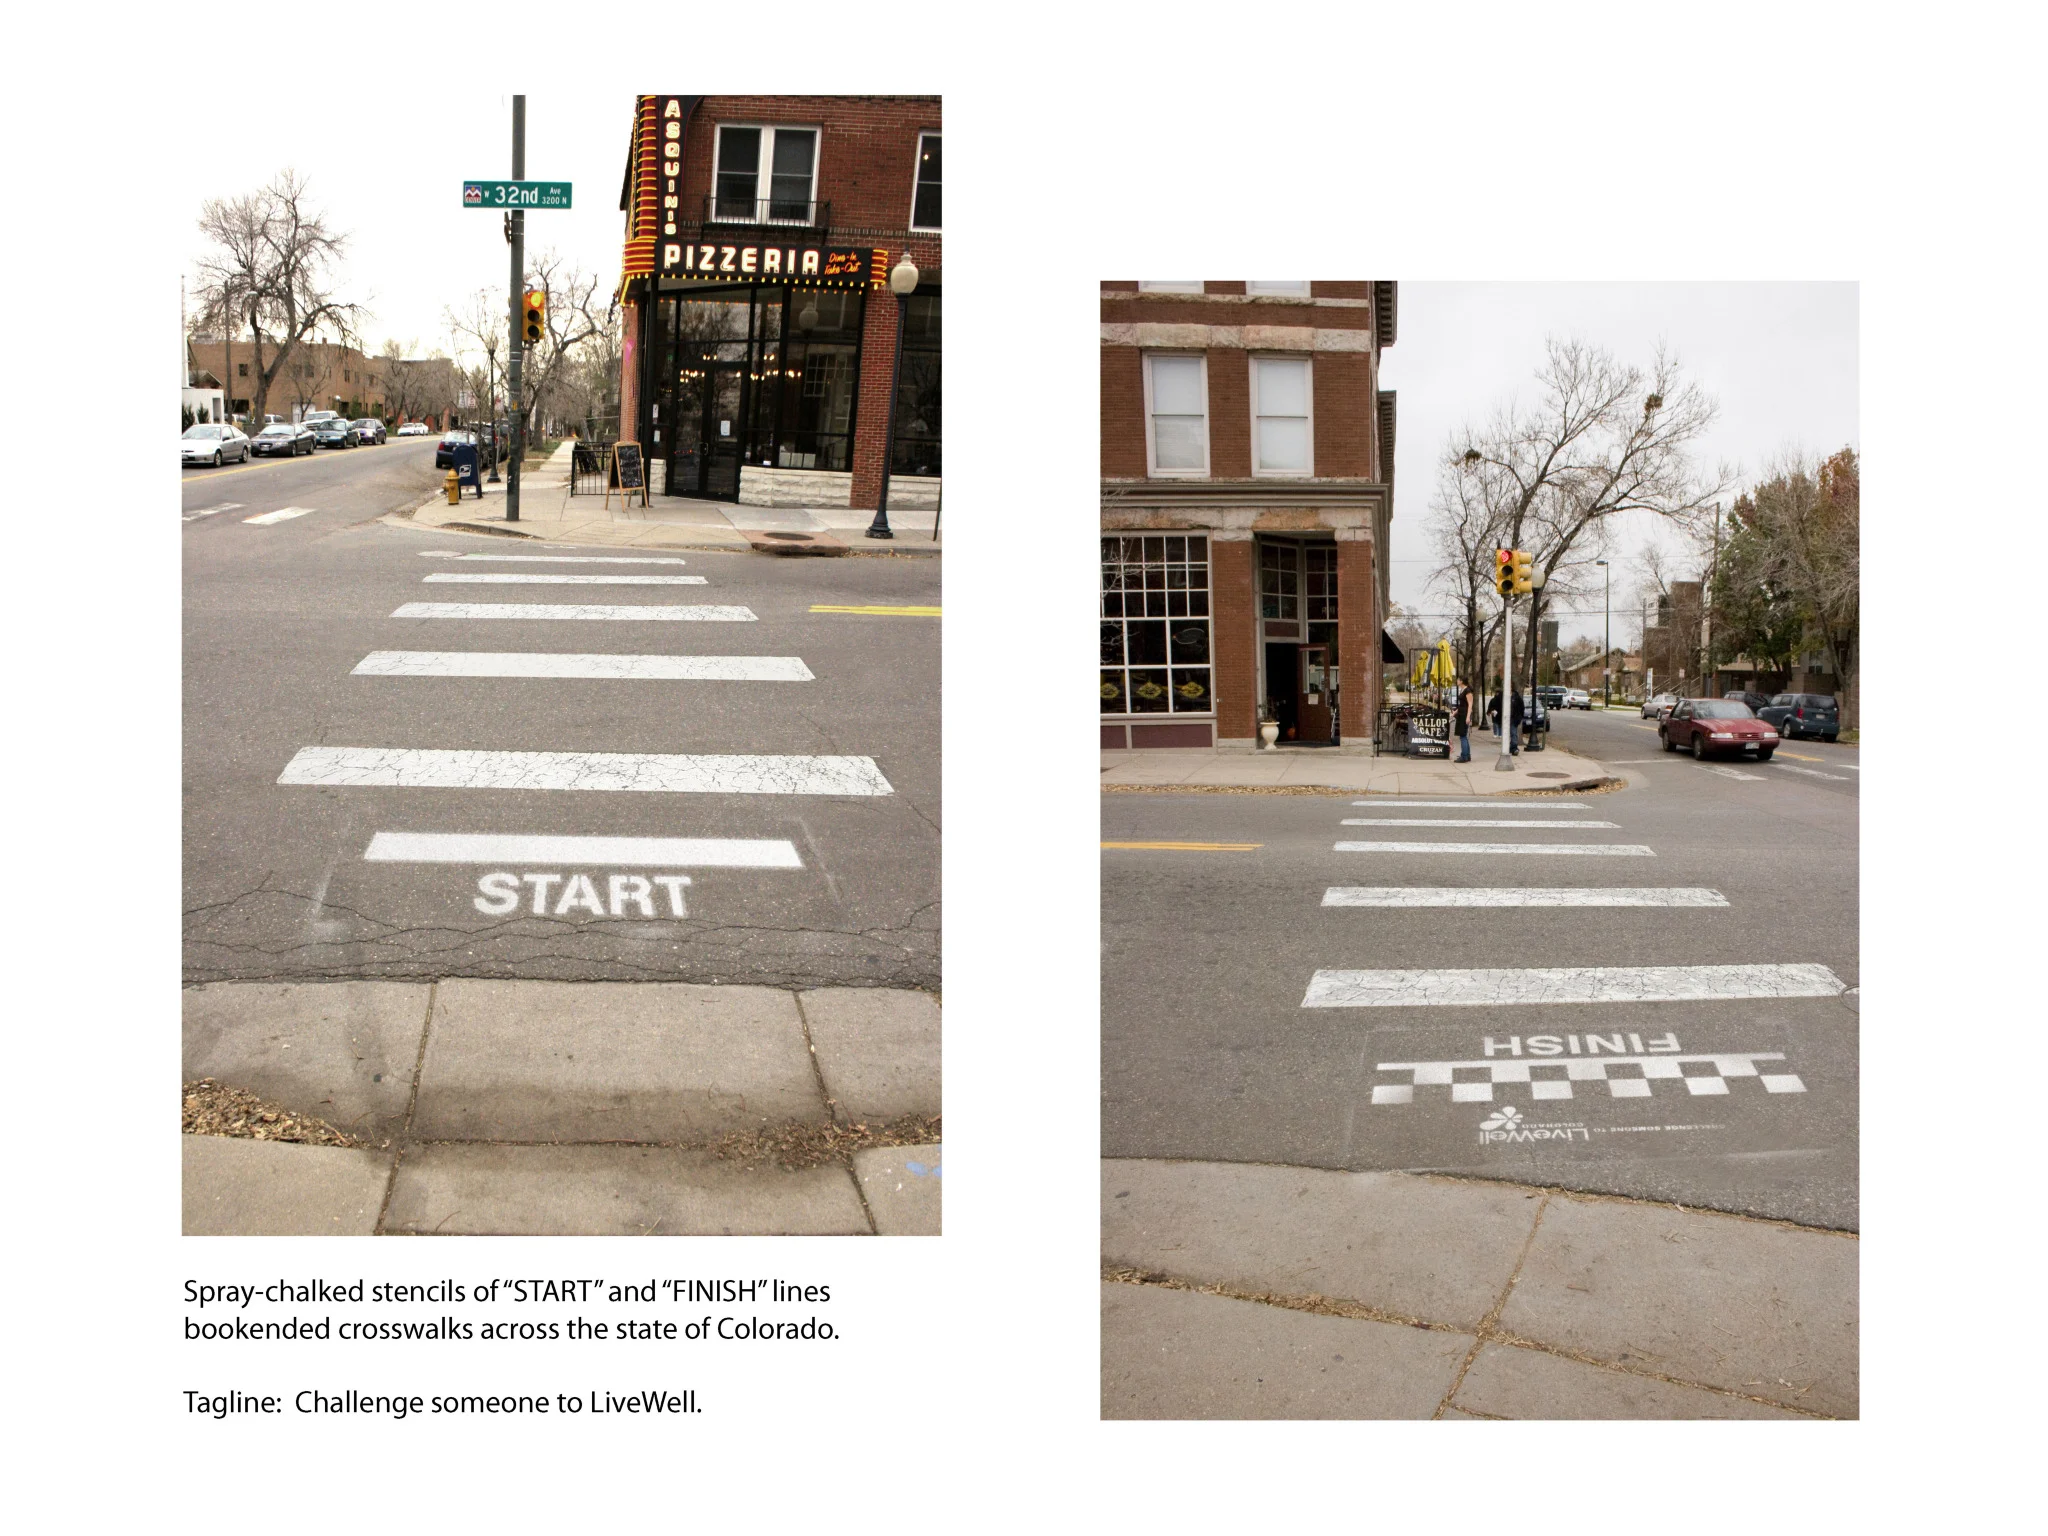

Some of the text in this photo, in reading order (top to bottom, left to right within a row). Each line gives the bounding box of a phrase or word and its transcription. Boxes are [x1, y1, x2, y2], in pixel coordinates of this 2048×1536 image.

[664, 99, 681, 236] ASQUINIS
[484, 186, 562, 204] W 32nd Ave
[541, 196, 567, 205] 3200 N
[663, 244, 821, 276] PIZZERIA
[1412, 717, 1448, 728] GALLOP
[474, 872, 692, 917] START
[1484, 1032, 1682, 1057] FINISH
[1479, 1127, 1590, 1145] LiveWell
